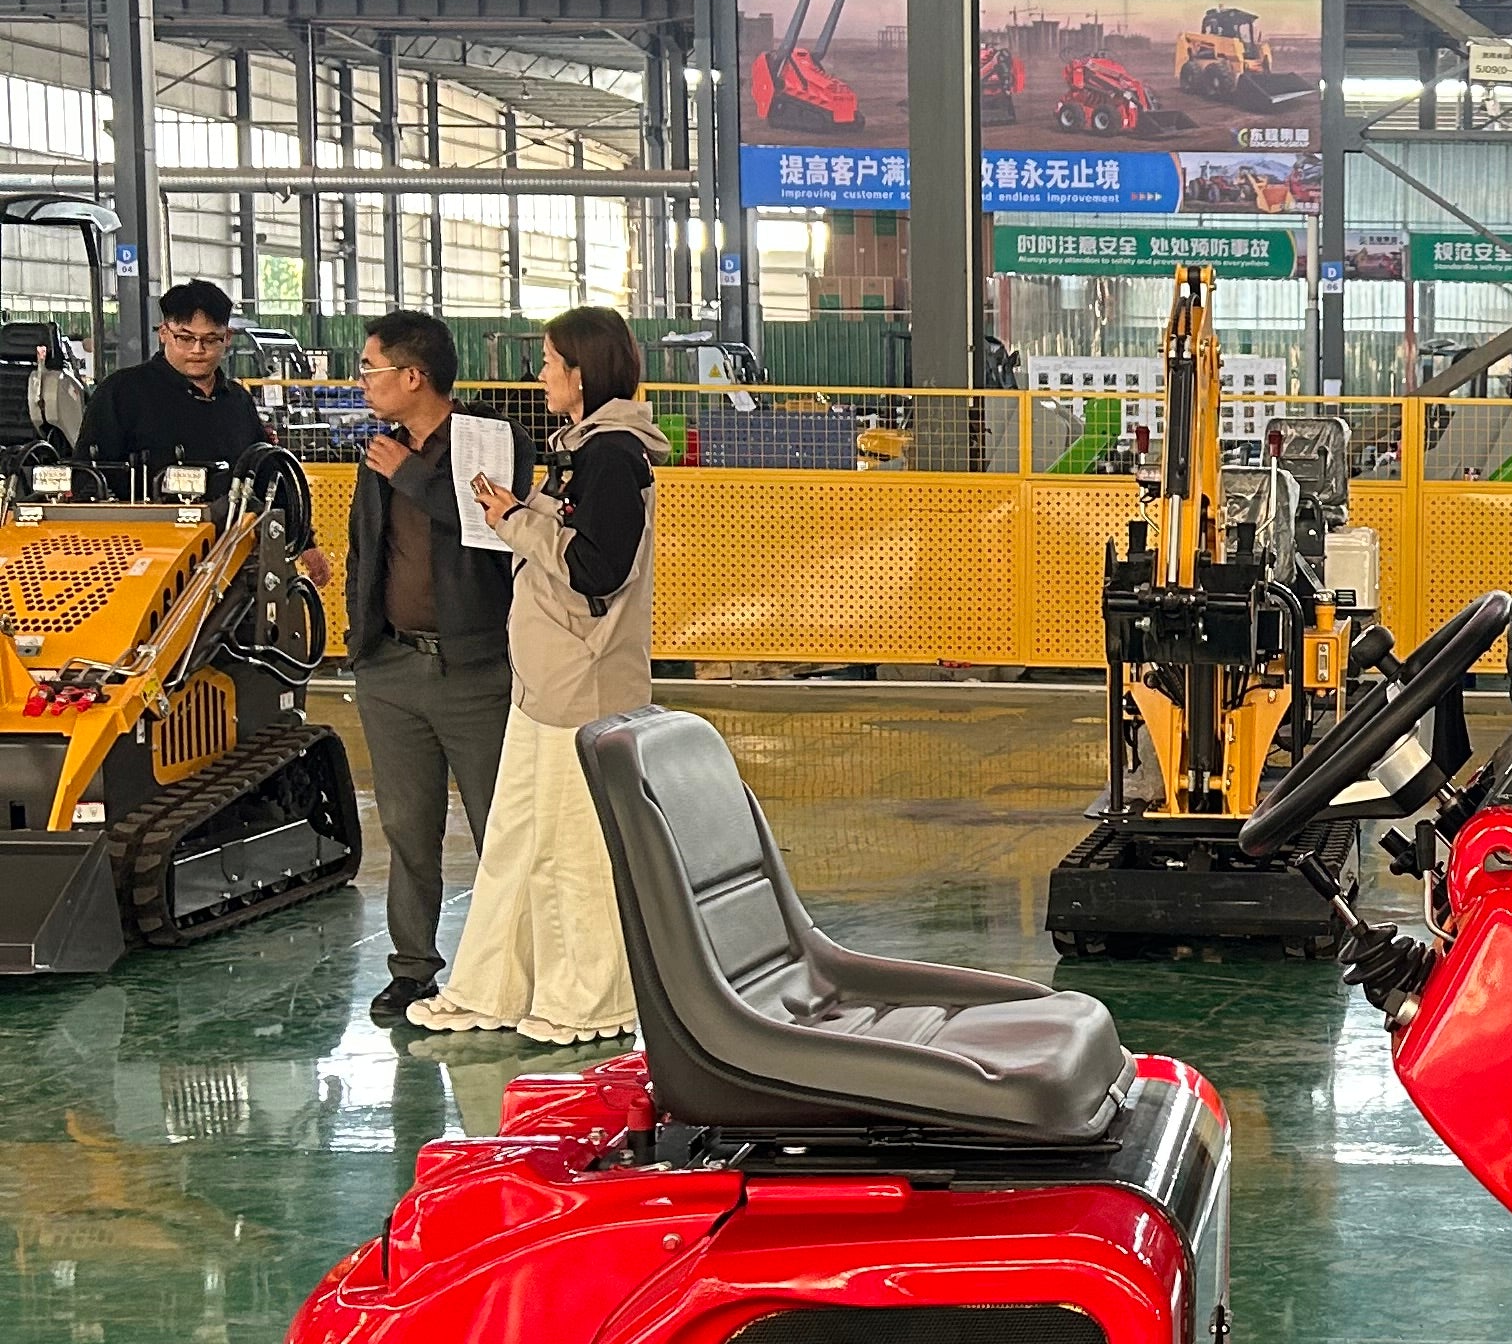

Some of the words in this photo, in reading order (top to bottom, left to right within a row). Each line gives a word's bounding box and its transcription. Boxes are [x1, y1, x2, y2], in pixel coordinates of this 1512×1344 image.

[780, 154, 910, 187] 提高客户满
[781, 189, 837, 200] Improving
[843, 190, 894, 199] customer
[999, 192, 1041, 202] endless
[1017, 234, 1138, 256] 时时注意安全
[1150, 237, 1270, 258] 处处预防事故
[122, 249, 132, 261] D
[725, 259, 734, 270] D
[1327, 267, 1337, 278] D
